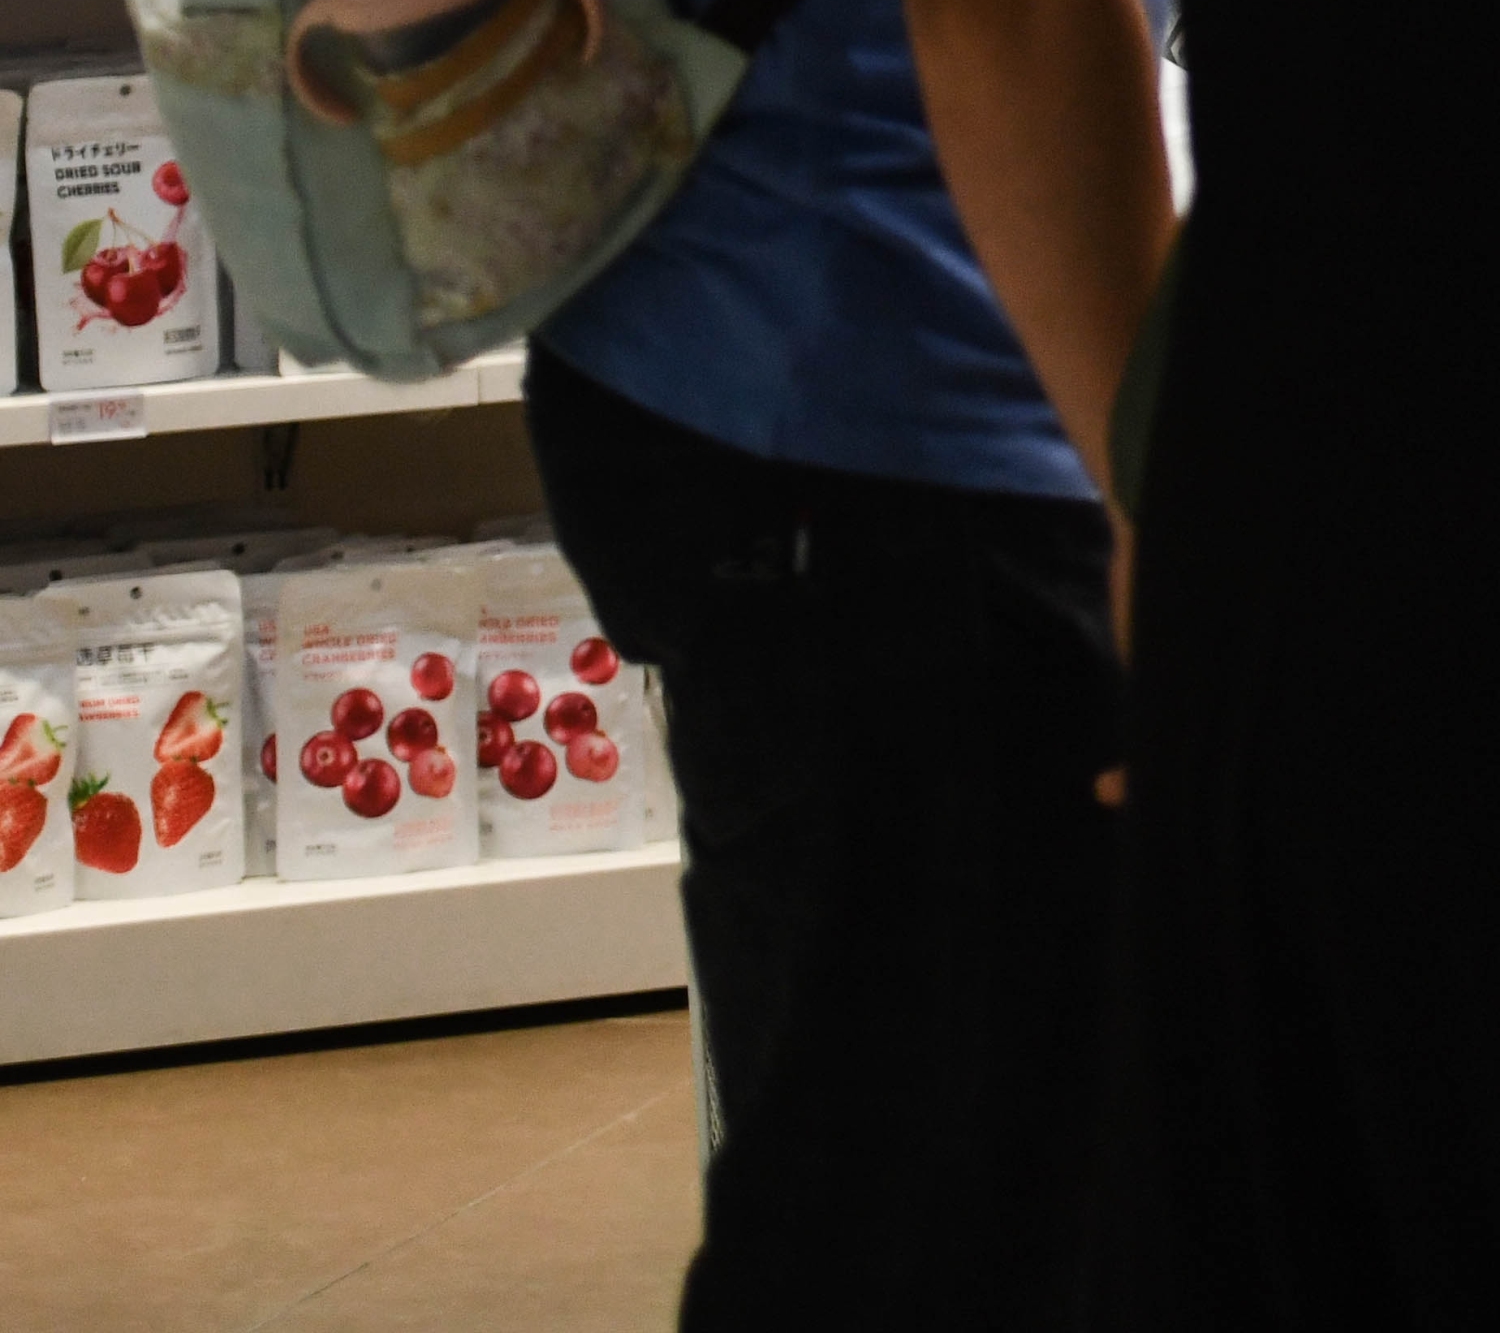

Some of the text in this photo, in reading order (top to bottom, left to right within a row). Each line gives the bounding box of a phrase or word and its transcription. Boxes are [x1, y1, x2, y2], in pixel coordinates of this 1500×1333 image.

[54, 161, 142, 182] DRIED SOUR
[56, 182, 120, 199] CHERRIES
